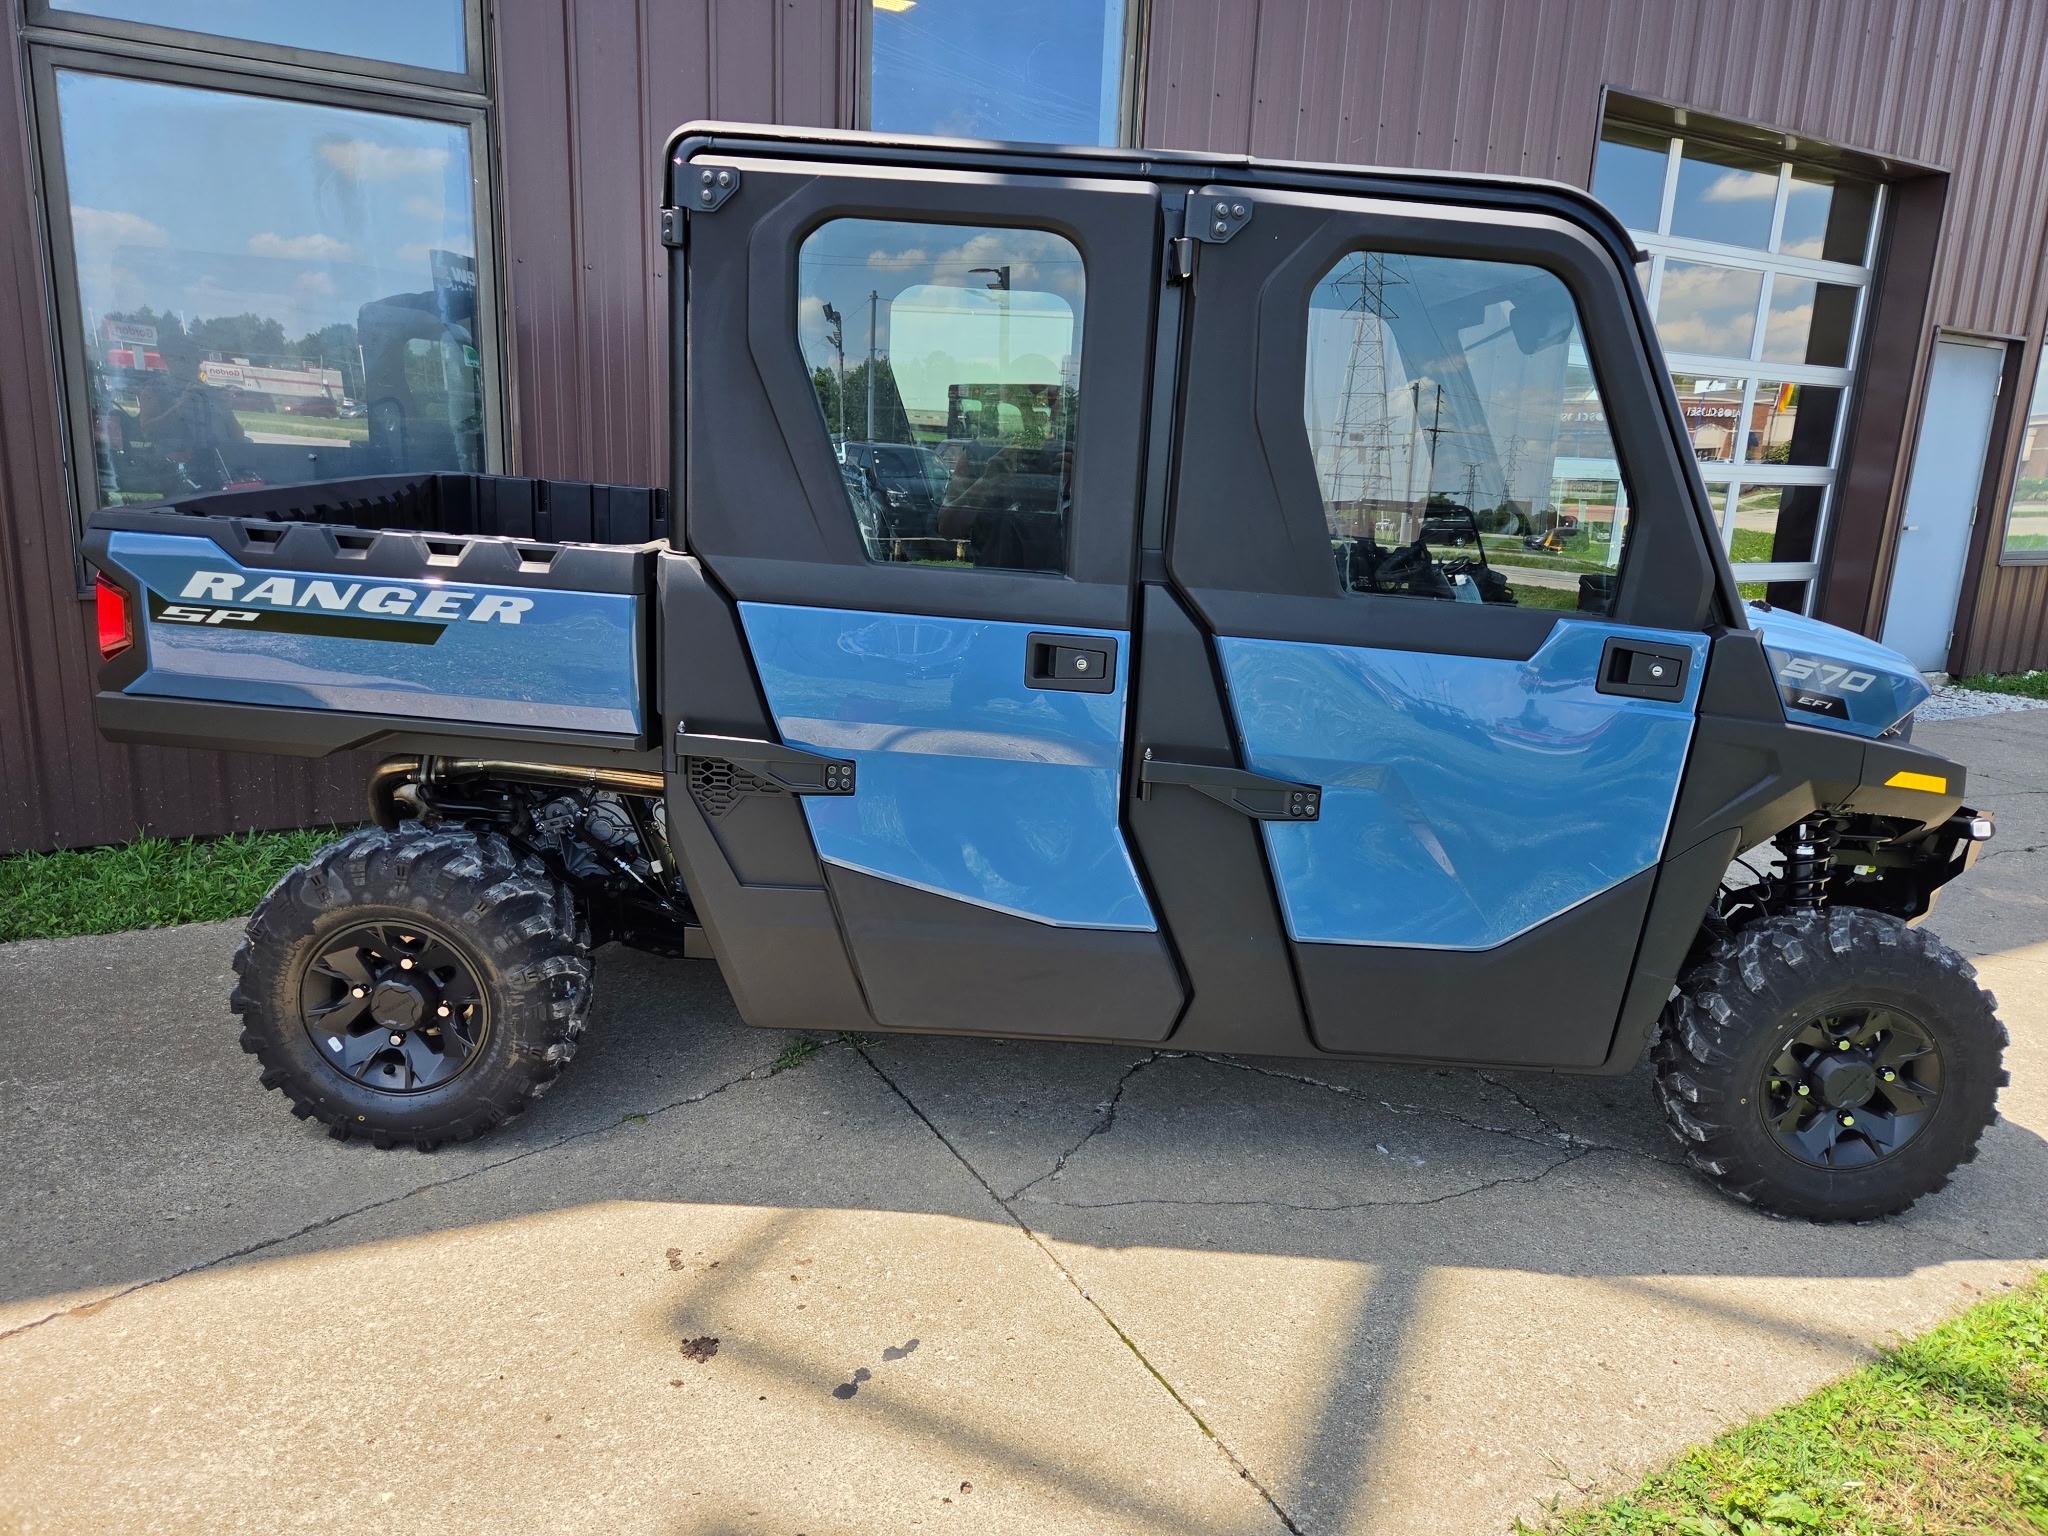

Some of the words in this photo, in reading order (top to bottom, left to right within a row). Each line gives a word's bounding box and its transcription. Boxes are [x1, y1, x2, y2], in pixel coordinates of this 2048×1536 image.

[179, 570, 535, 625] RANGER
[156, 605, 262, 625] SP
[1779, 657, 1877, 693] 570
[1797, 696, 1833, 710] EFI
